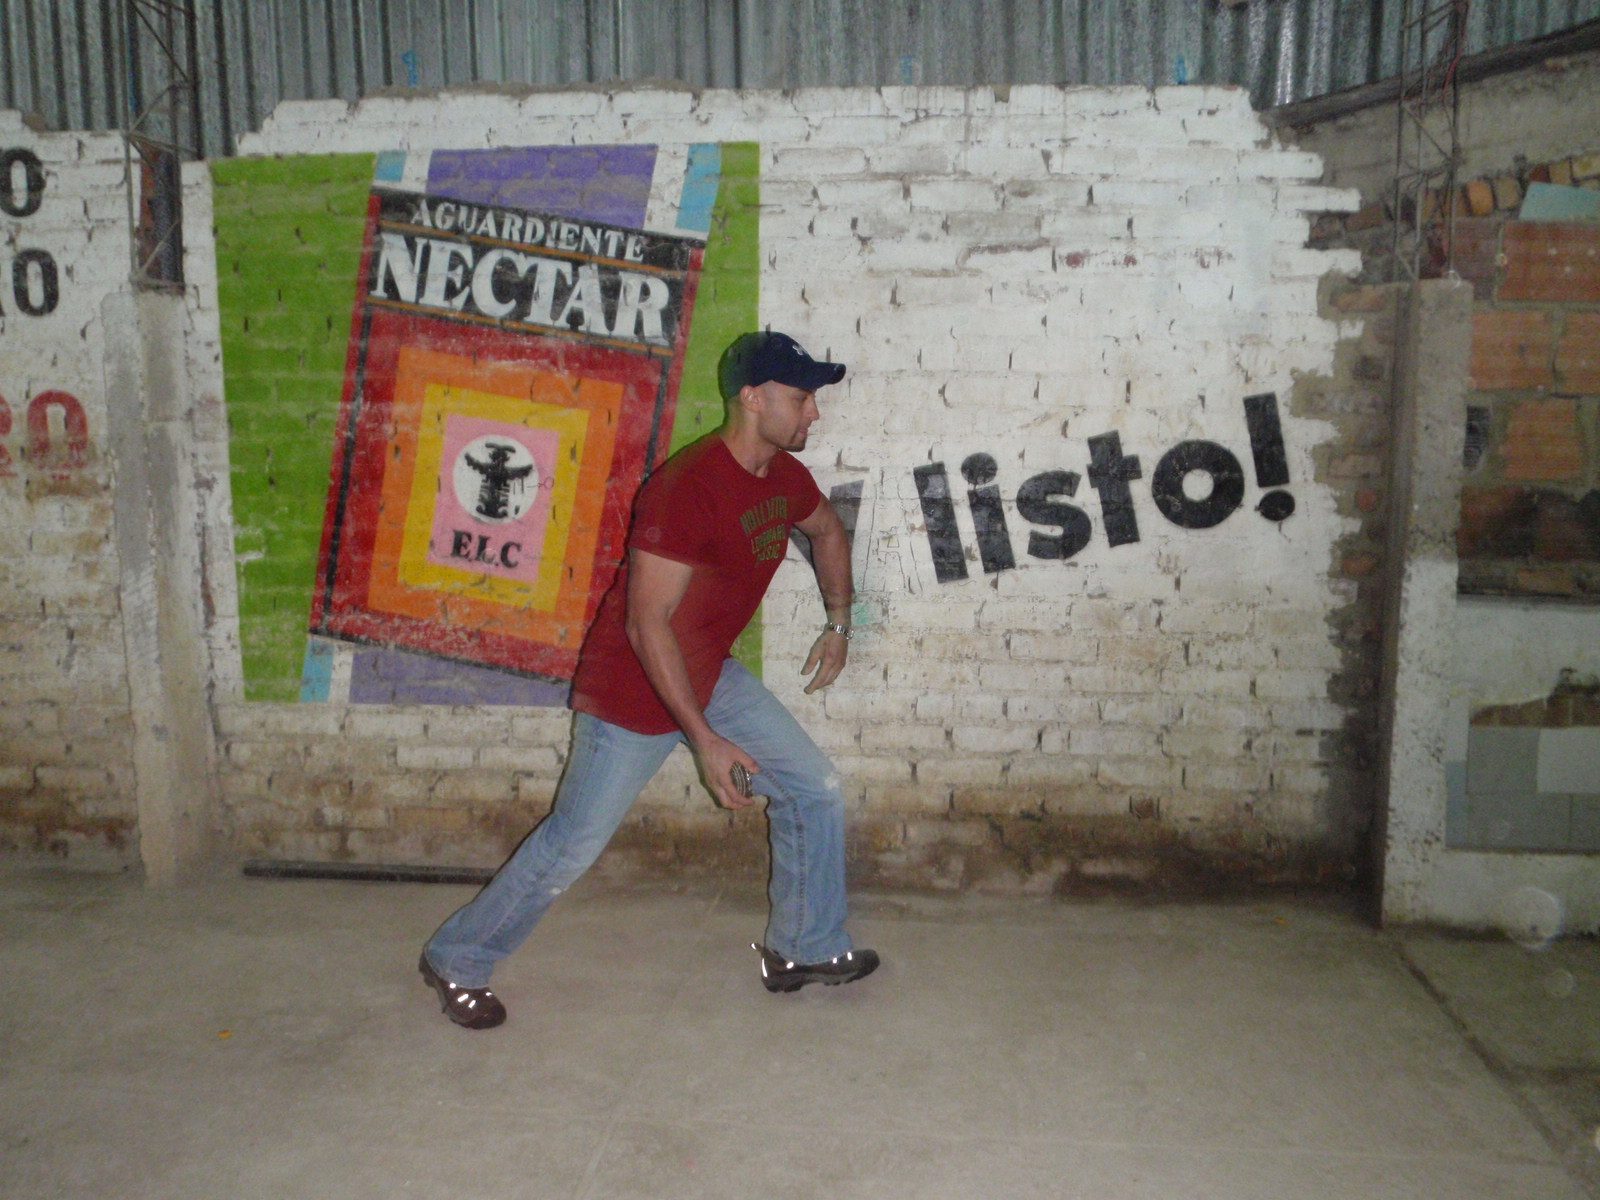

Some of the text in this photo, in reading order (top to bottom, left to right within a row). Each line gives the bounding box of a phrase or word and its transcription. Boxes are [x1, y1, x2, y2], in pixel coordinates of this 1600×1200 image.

[410, 198, 645, 263] AGUARDIENTE
[369, 232, 671, 347] NECTAR
[912, 391, 1296, 584] listo!
